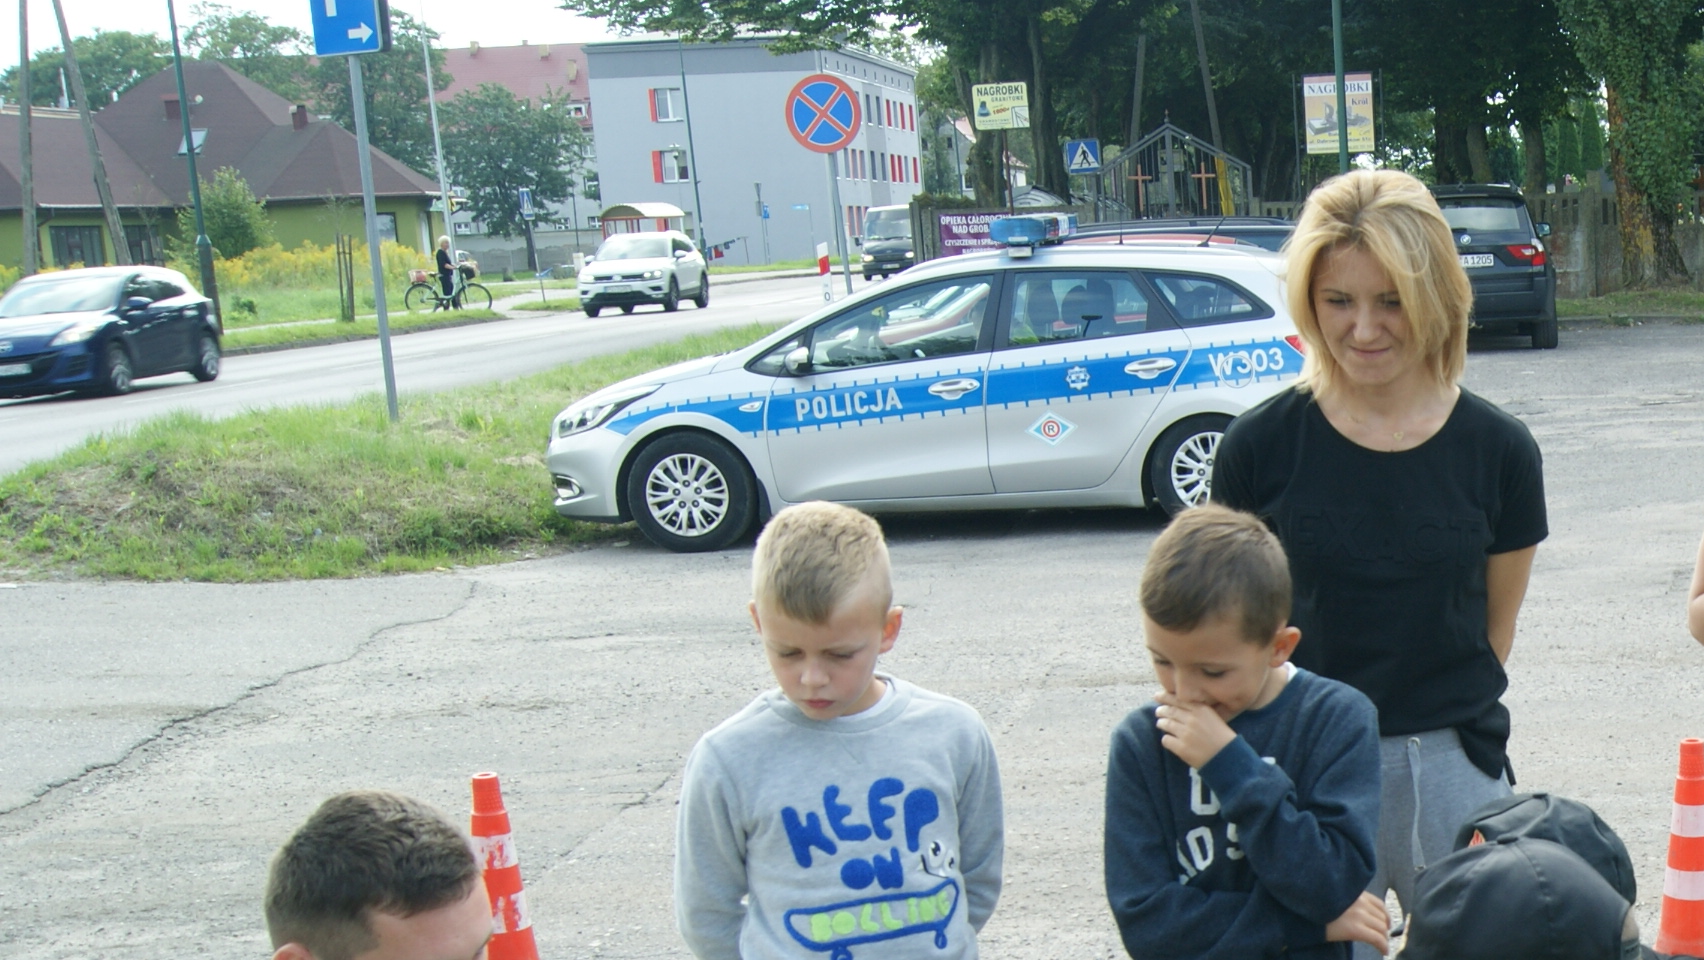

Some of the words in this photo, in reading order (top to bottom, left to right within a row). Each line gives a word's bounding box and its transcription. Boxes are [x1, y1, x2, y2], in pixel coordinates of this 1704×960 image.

[977, 85, 1023, 96] NAGROBKI
[941, 215, 964, 225] OPIEKA
[952, 225, 968, 233] NAD
[1459, 257, 1469, 265] A
[1471, 256, 1492, 265] 1205
[1208, 347, 1284, 377] W303
[795, 387, 903, 421] POLICJA
[1047, 424, 1055, 433] R
[781, 777, 939, 868] KEEP
[840, 847, 903, 890] ON
